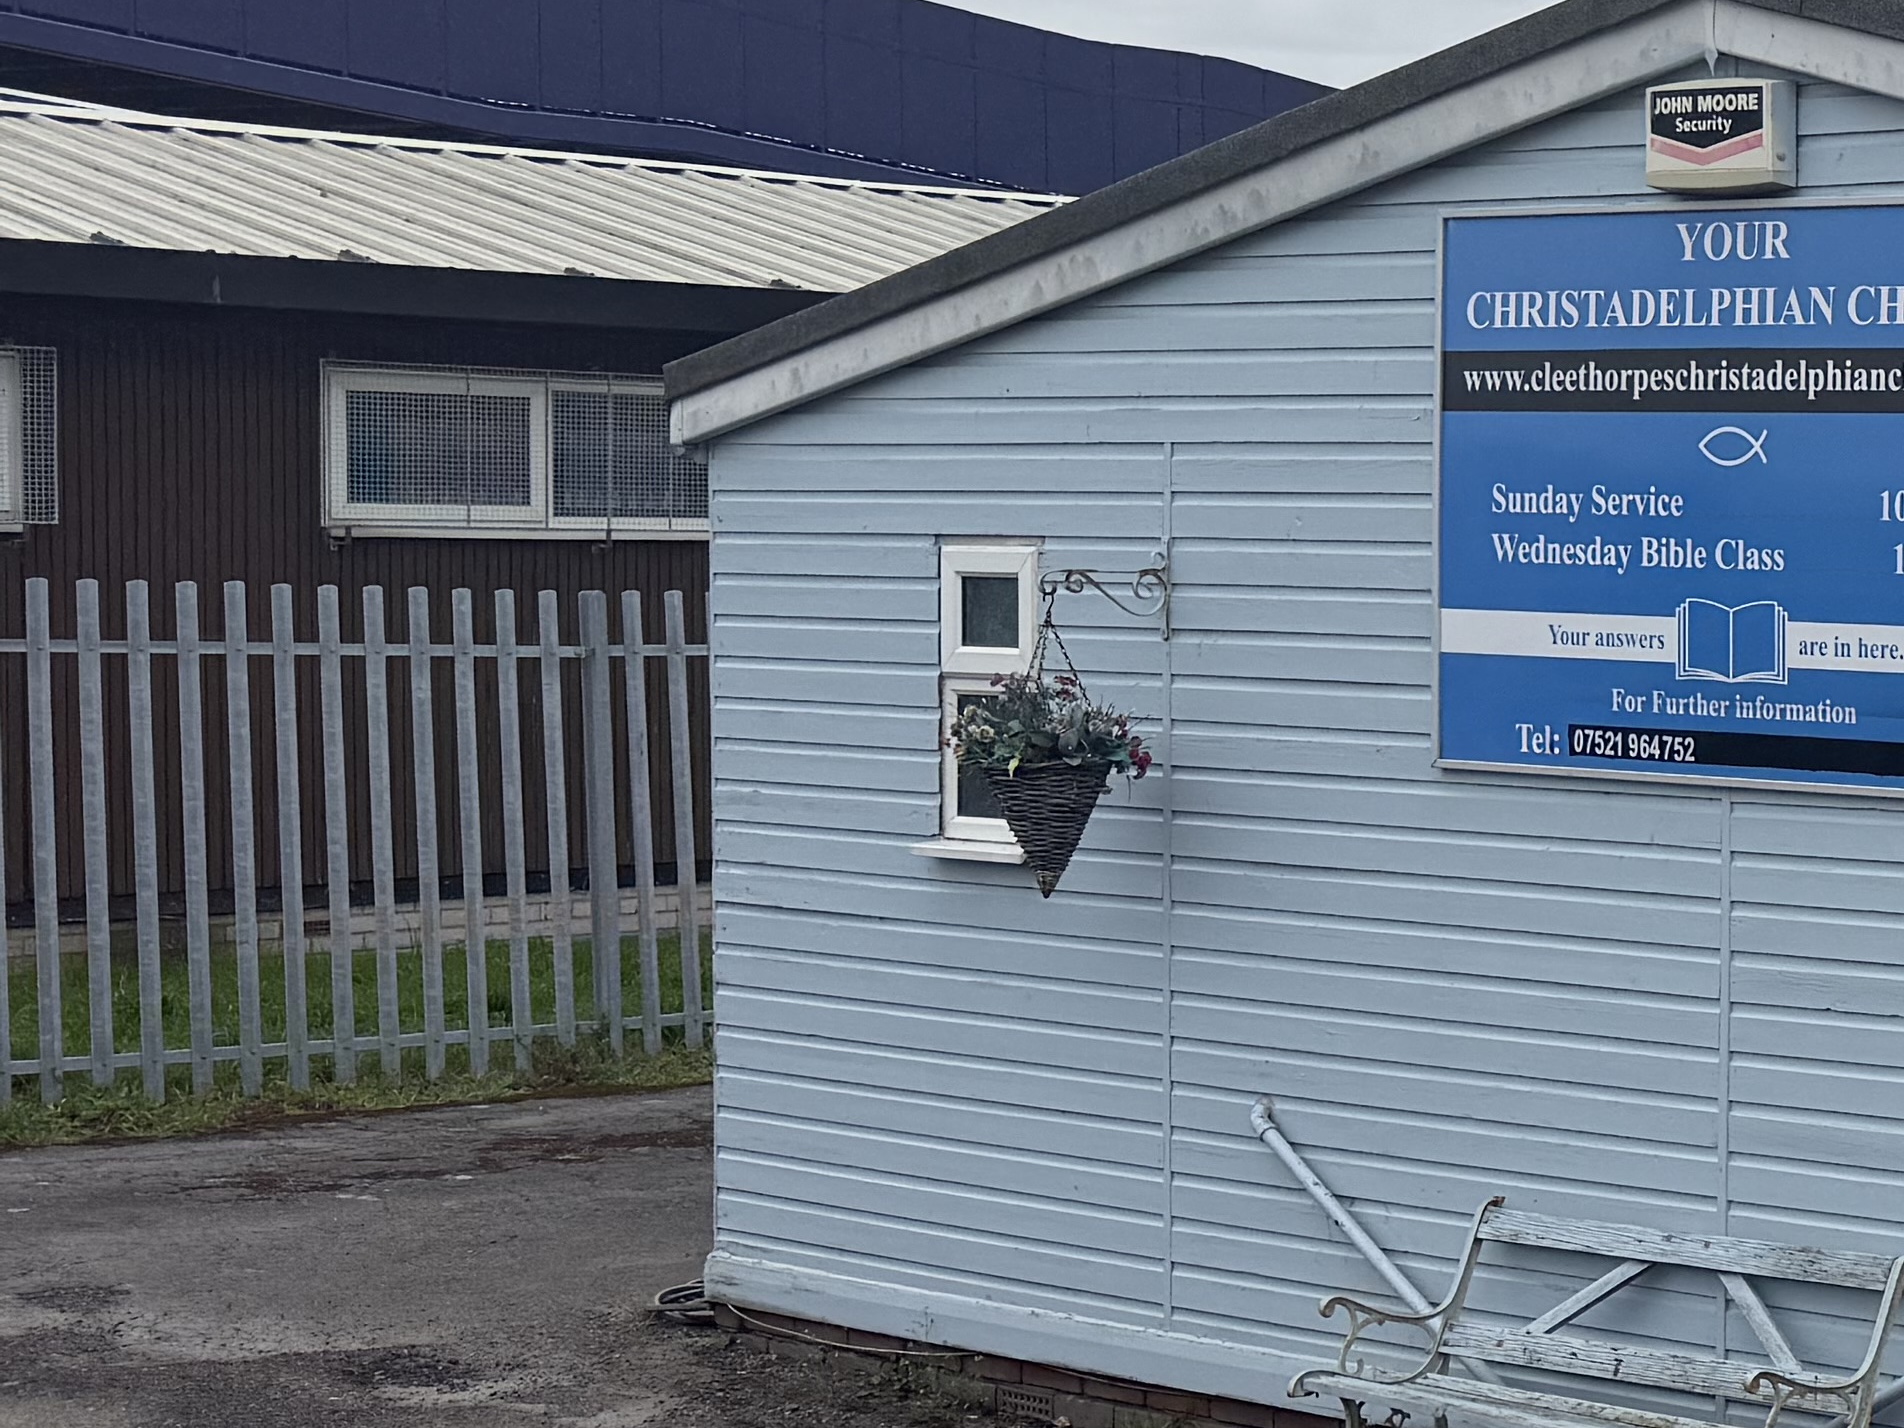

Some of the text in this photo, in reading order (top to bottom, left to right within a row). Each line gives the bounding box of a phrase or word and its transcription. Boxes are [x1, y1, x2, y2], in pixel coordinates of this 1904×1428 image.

[1655, 93, 1758, 115] JOHN MOORE
[1676, 115, 1732, 134] Security
[1676, 220, 1790, 262] YOUR
[1465, 285, 1836, 329] CHRISTADELPHIAN
[1491, 483, 1684, 523] Sunday Service
[1491, 533, 1785, 573] Wednesday Bible Class
[1548, 624, 1665, 651] Your answers
[1798, 640, 1829, 658] are
[1833, 636, 1852, 658] in
[1611, 688, 1857, 725] For Further information
[1515, 723, 1695, 762] Tel: 07521 964752
